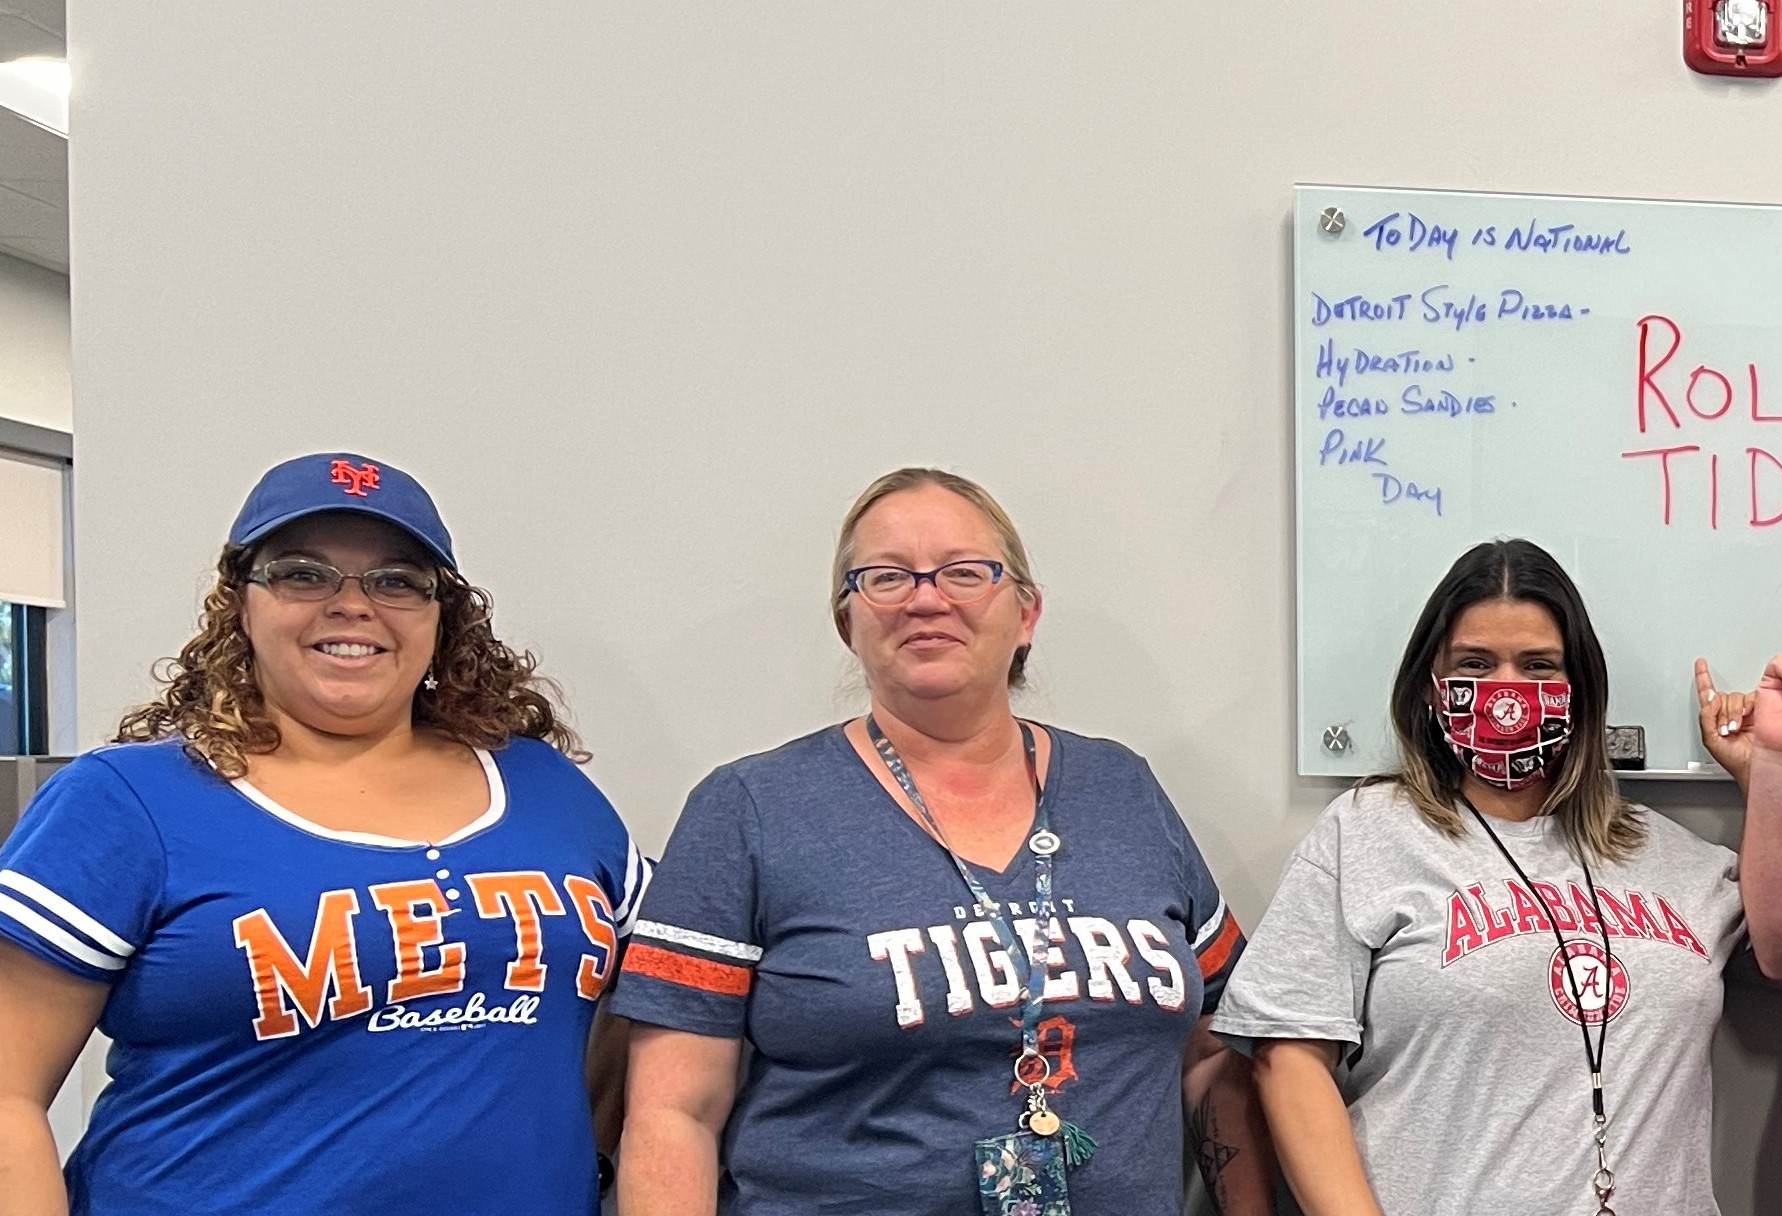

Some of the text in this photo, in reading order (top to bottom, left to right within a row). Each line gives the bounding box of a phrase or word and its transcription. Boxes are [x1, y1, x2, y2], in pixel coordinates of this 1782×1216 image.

[232, 869, 618, 1041] METS
[866, 917, 1186, 1030] TIGERS
[1441, 878, 1712, 968] ALABAMA
[367, 992, 541, 1032] Baseball
